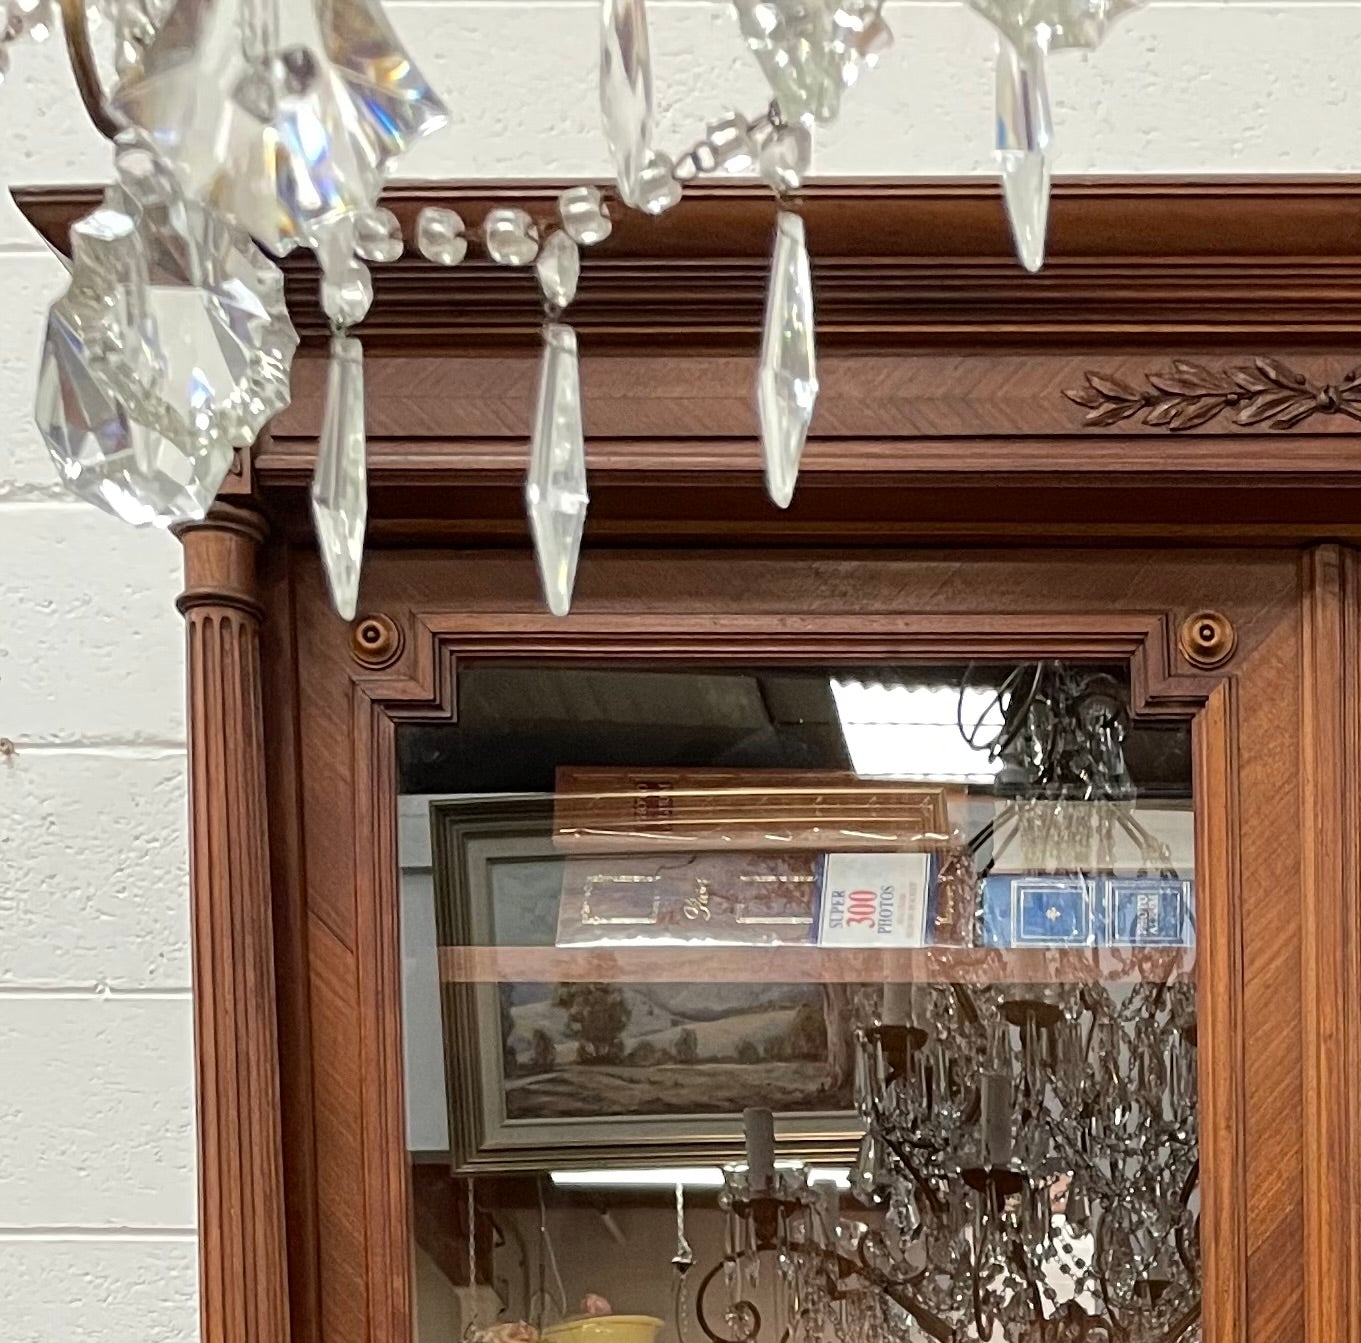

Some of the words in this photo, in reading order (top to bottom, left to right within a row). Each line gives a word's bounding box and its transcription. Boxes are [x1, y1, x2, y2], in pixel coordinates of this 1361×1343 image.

[829, 890, 846, 929] SUPER
[846, 890, 878, 929] 300
[877, 885, 896, 935] PHOTOS
